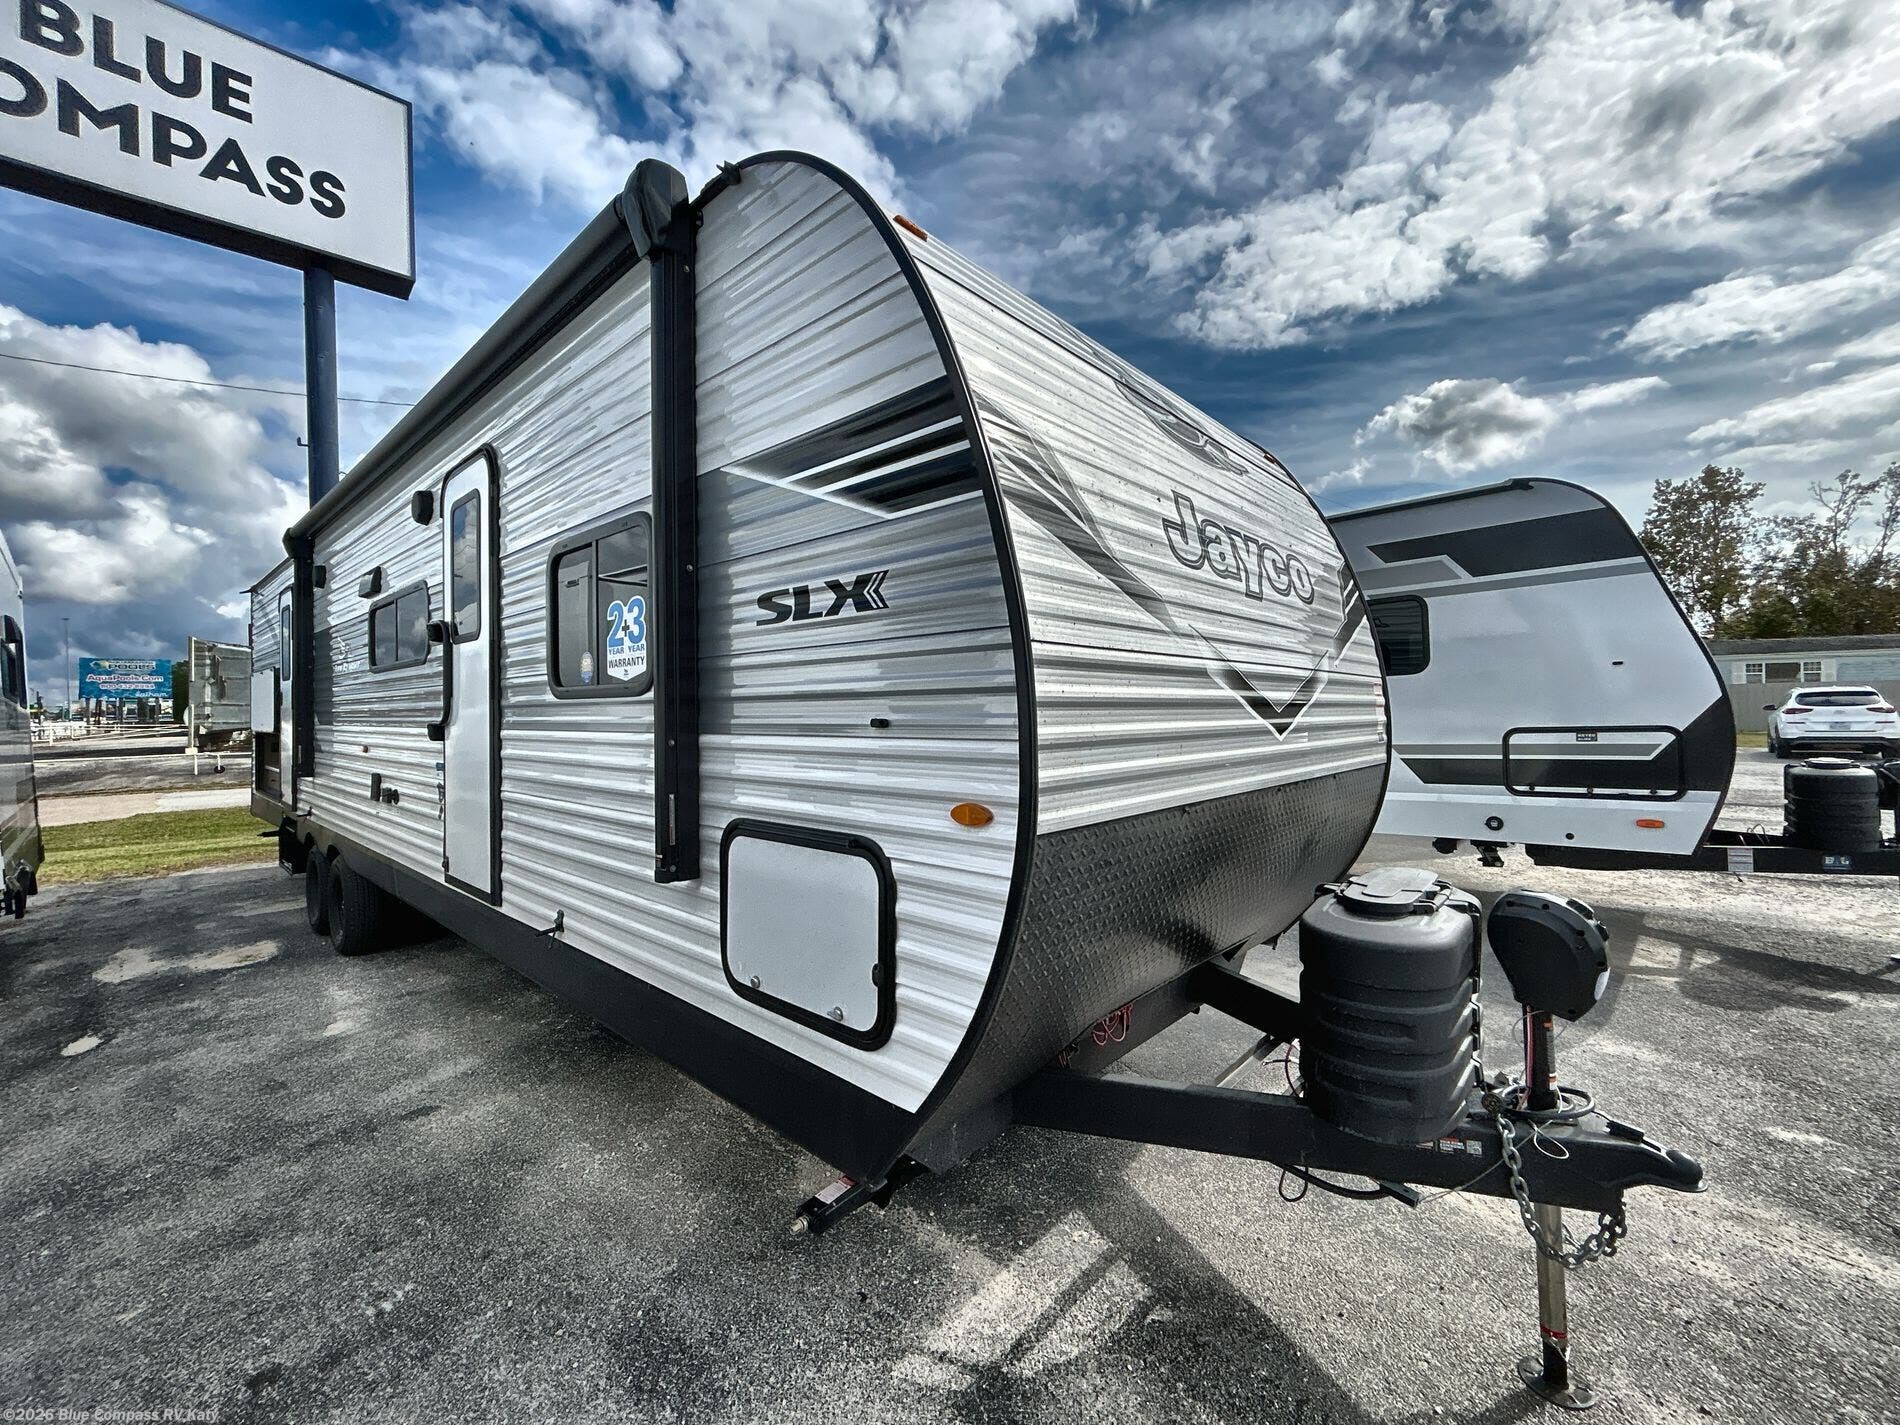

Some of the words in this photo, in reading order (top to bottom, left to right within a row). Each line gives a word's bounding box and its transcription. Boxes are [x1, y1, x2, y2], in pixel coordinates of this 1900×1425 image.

[20, 0, 253, 124] BLUE
[1161, 489, 1315, 605] Jayco
[756, 569, 890, 627] SLX
[608, 646, 625, 655] YEAR
[627, 643, 645, 653] YEAR
[608, 656, 645, 669] WARRANTY
